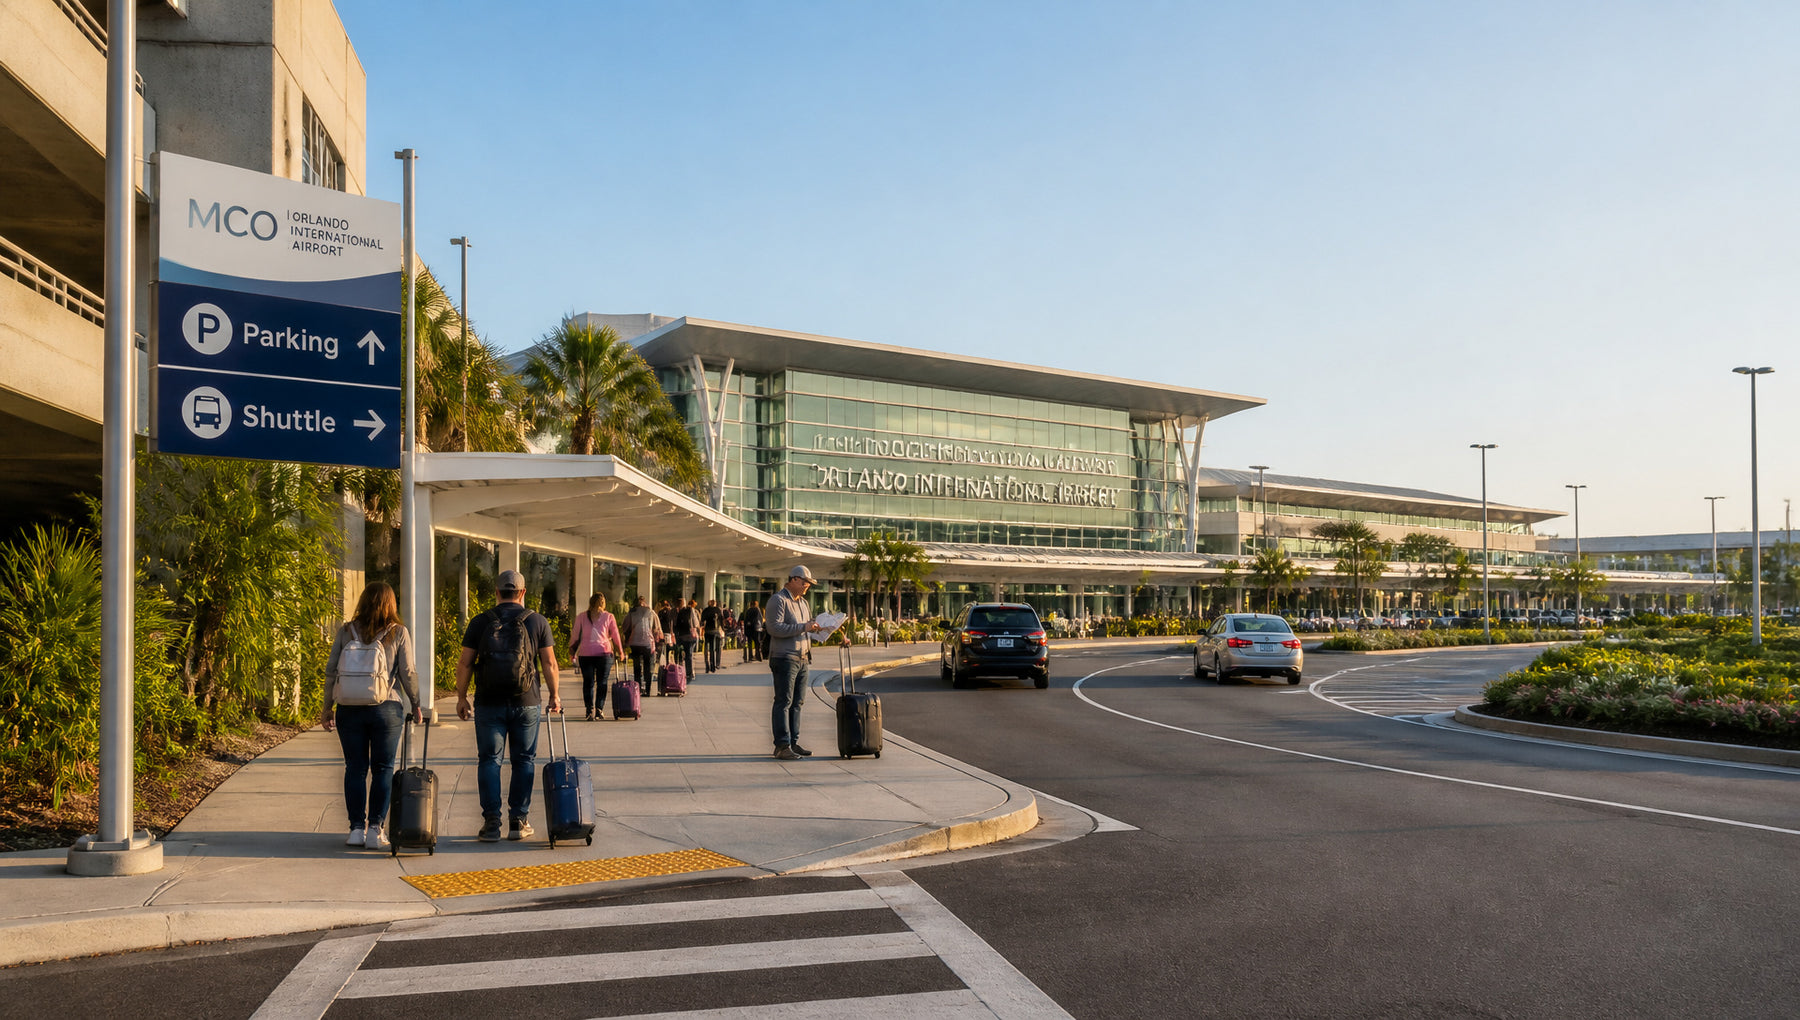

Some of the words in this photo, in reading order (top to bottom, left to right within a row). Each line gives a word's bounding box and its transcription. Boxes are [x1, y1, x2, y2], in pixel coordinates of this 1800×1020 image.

[188, 198, 278, 241] MCO
[292, 211, 349, 231] ORLANDO
[292, 240, 344, 257] AIRPORT
[198, 312, 220, 344] P
[243, 322, 339, 360] Parking
[242, 404, 336, 434] Shuttle
